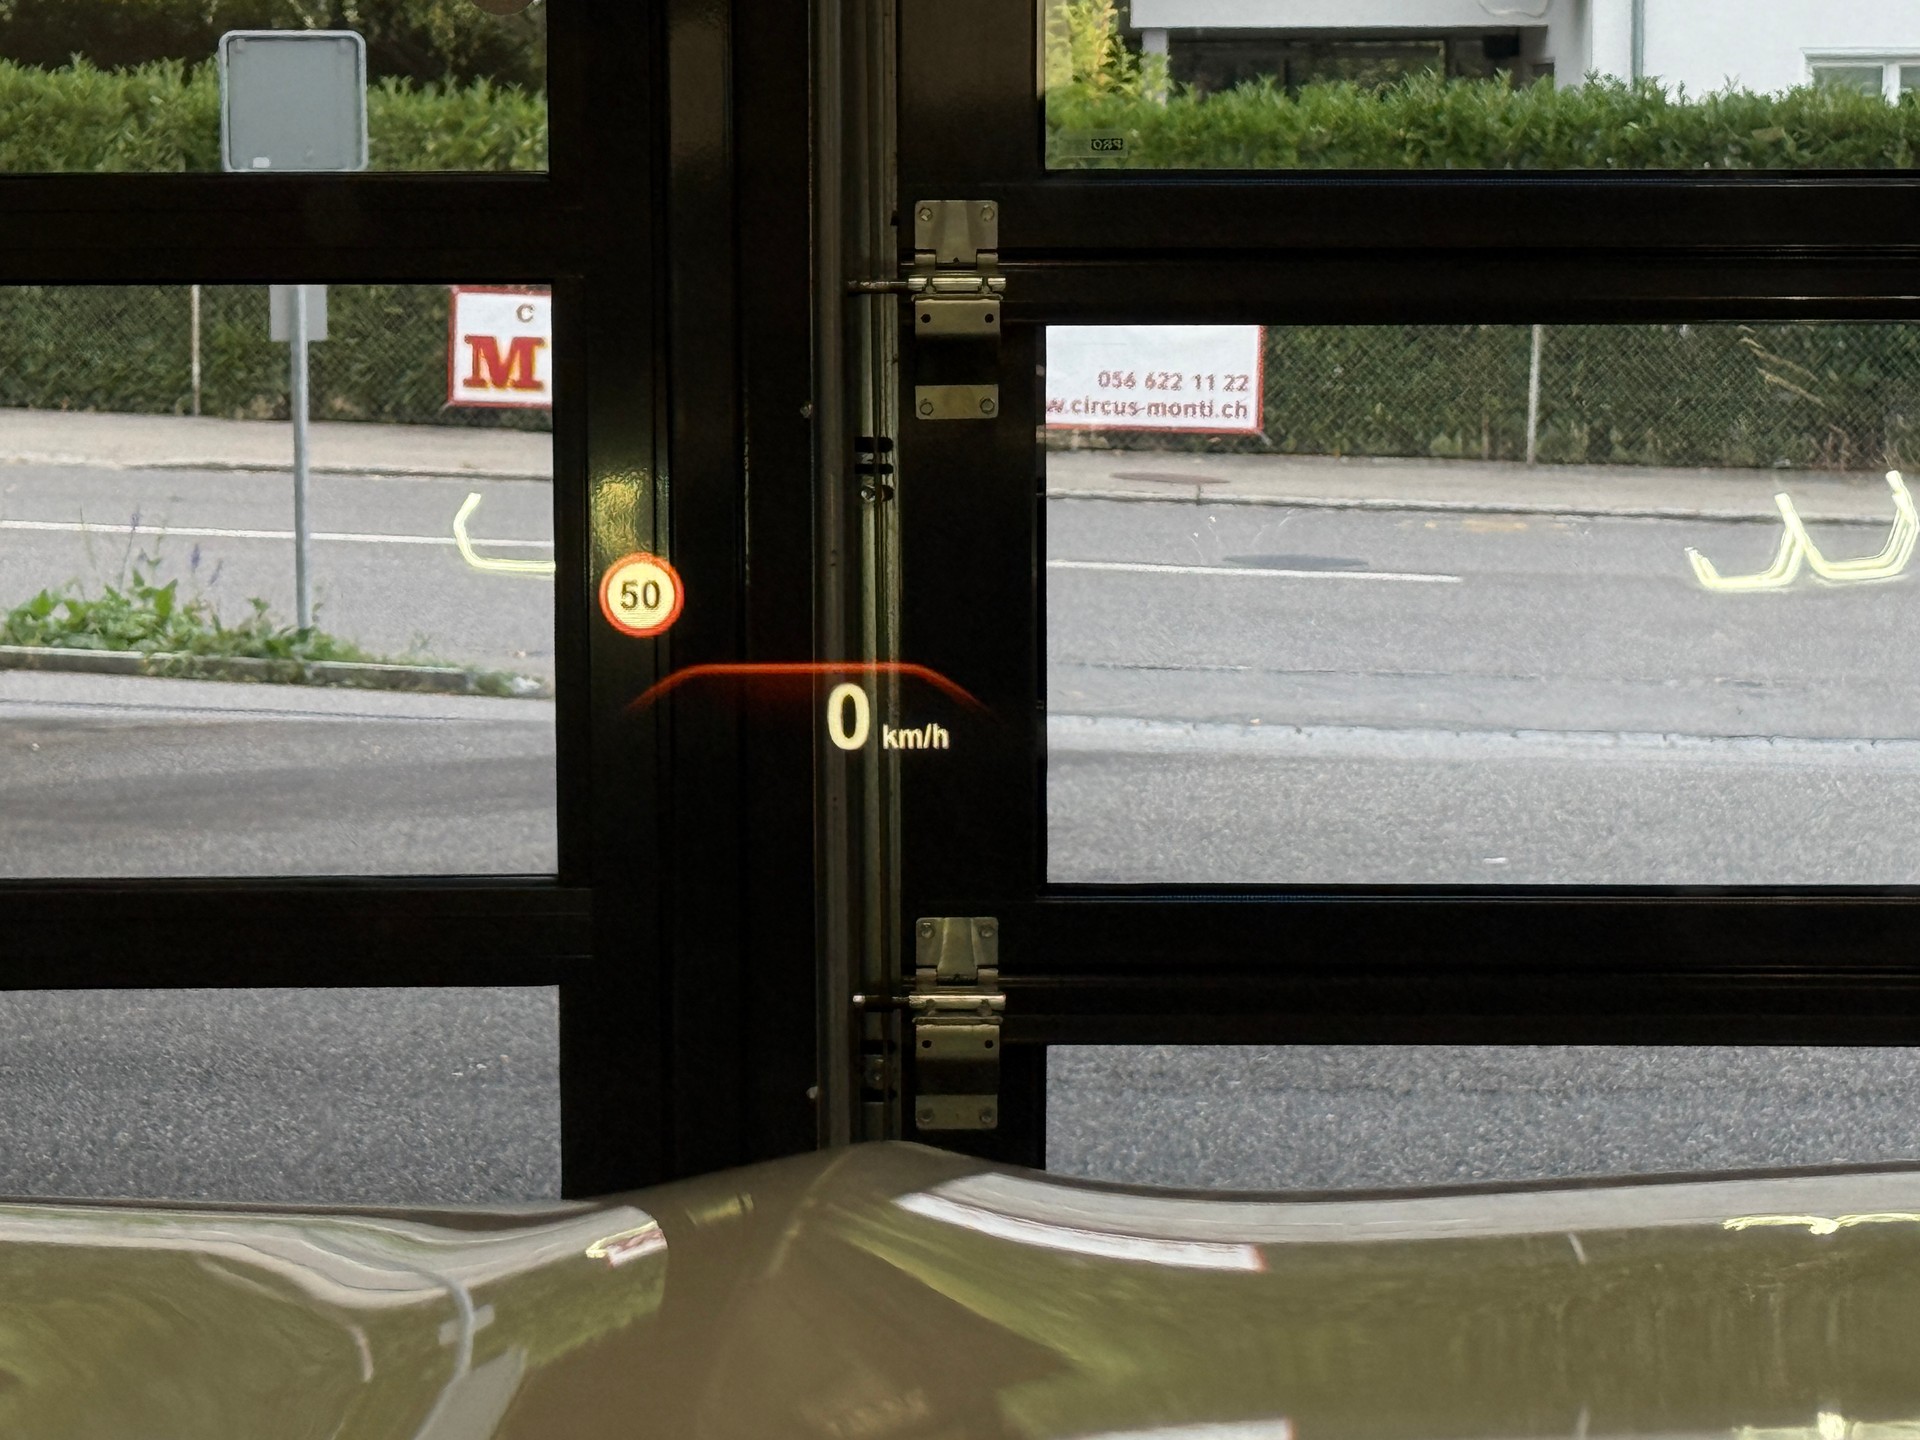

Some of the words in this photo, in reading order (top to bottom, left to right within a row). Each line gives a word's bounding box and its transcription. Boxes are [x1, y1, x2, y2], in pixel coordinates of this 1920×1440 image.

[463, 334, 546, 392] M
[1098, 370, 1136, 389] 056
[1145, 372, 1182, 391] 622
[1194, 374, 1215, 391] 11
[1223, 374, 1249, 392] 22
[620, 580, 661, 610] 50
[827, 682, 870, 750] 0
[883, 723, 950, 749] km/h
